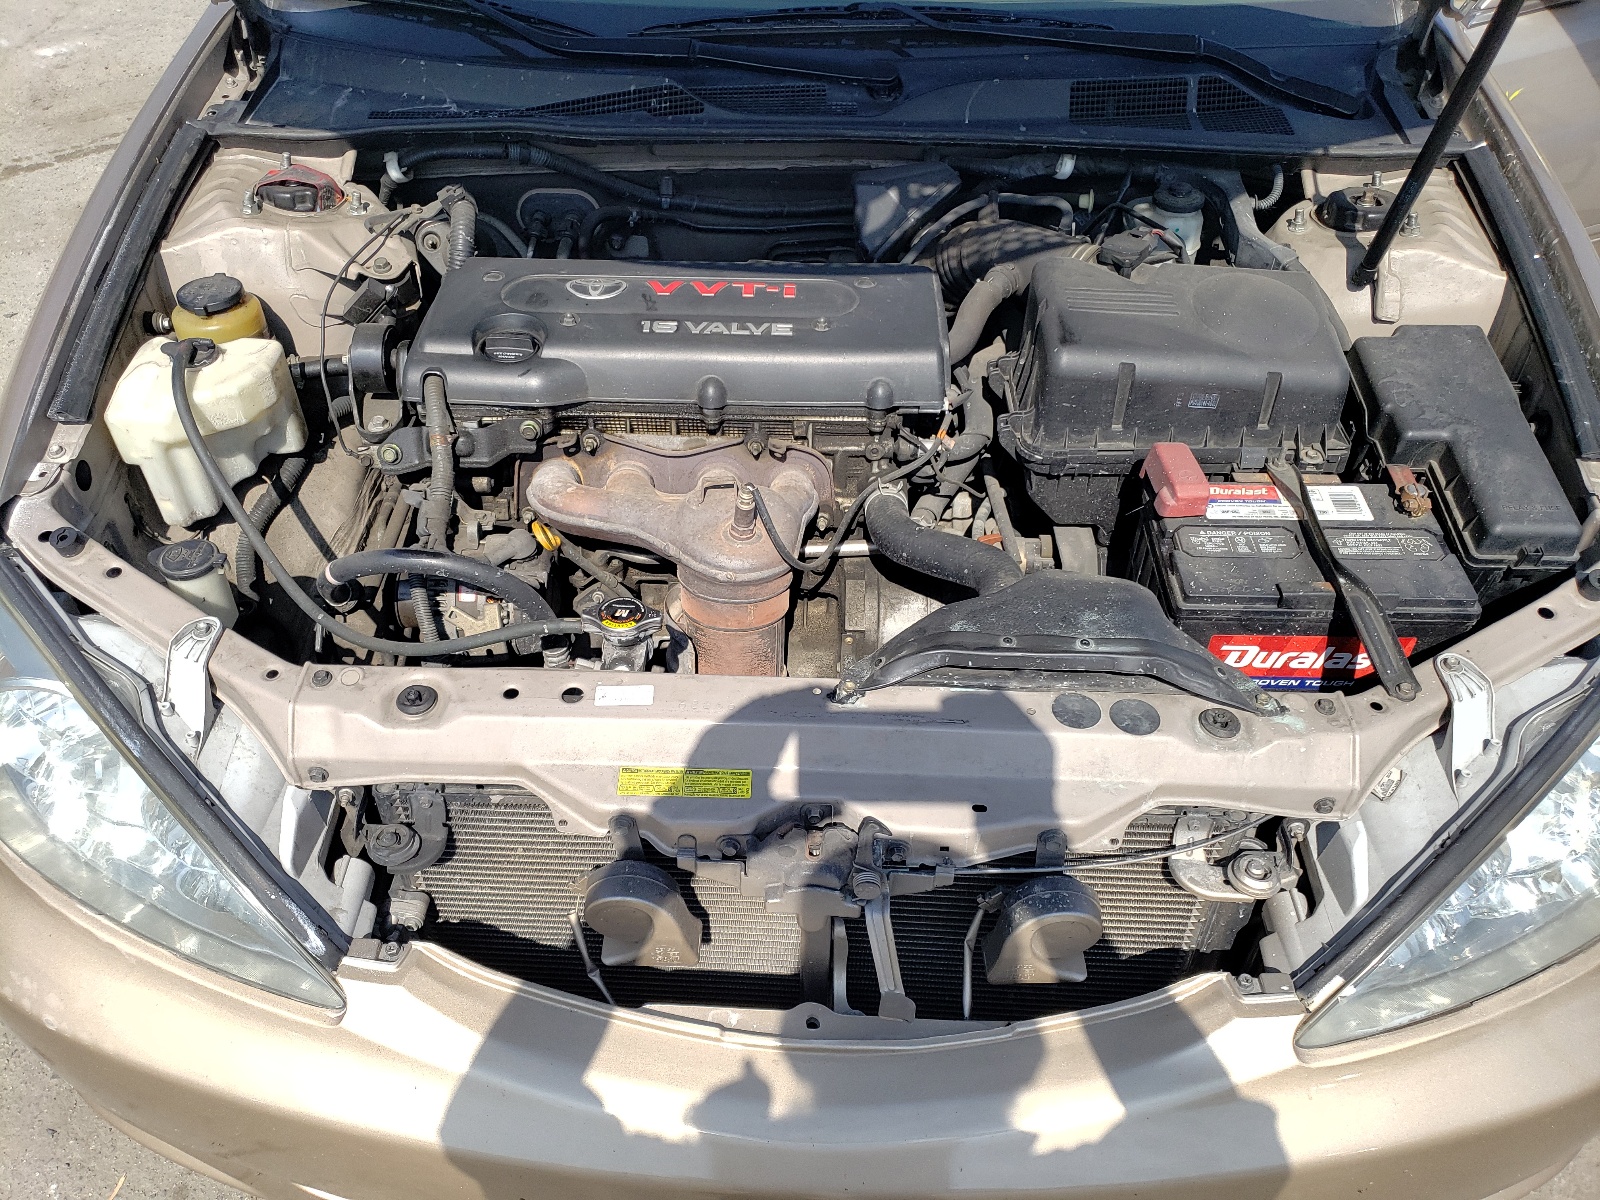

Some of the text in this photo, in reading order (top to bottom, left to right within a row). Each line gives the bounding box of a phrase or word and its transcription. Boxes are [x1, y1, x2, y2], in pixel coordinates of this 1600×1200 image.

[640, 320, 794, 336] 16 VALVE
[1209, 486, 1268, 495] Duralast
[1219, 644, 1371, 669] Duralas
[1305, 679, 1355, 687] TOUGH
